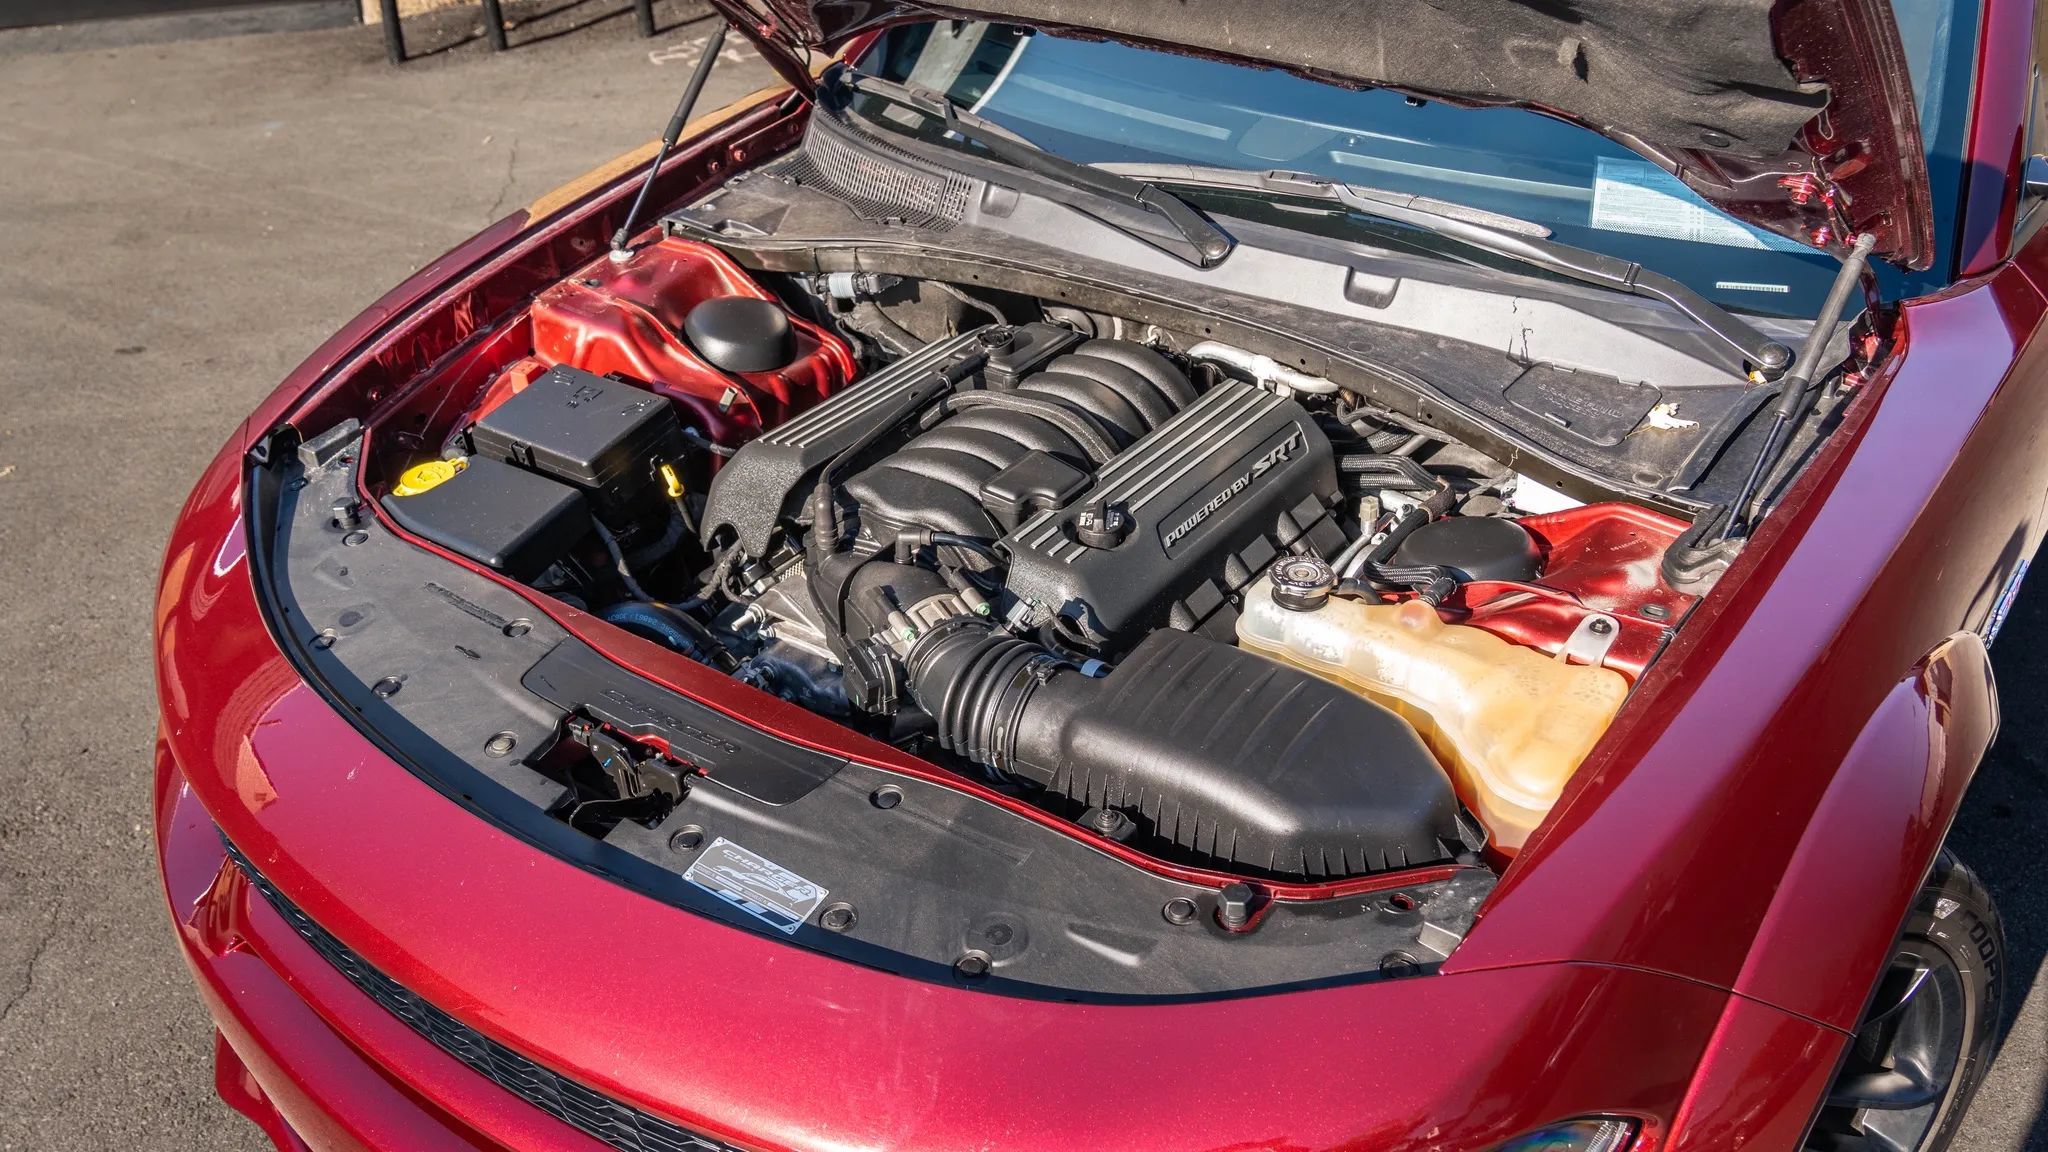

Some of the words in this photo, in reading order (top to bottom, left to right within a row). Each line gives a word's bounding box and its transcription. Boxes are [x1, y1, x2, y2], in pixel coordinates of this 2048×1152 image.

[1165, 489, 1233, 548] POWERED
[1232, 471, 1251, 495] BY
[1252, 430, 1301, 480] SRT
[722, 848, 813, 897] CHARGER
[1962, 909, 2000, 1009] COOPE
